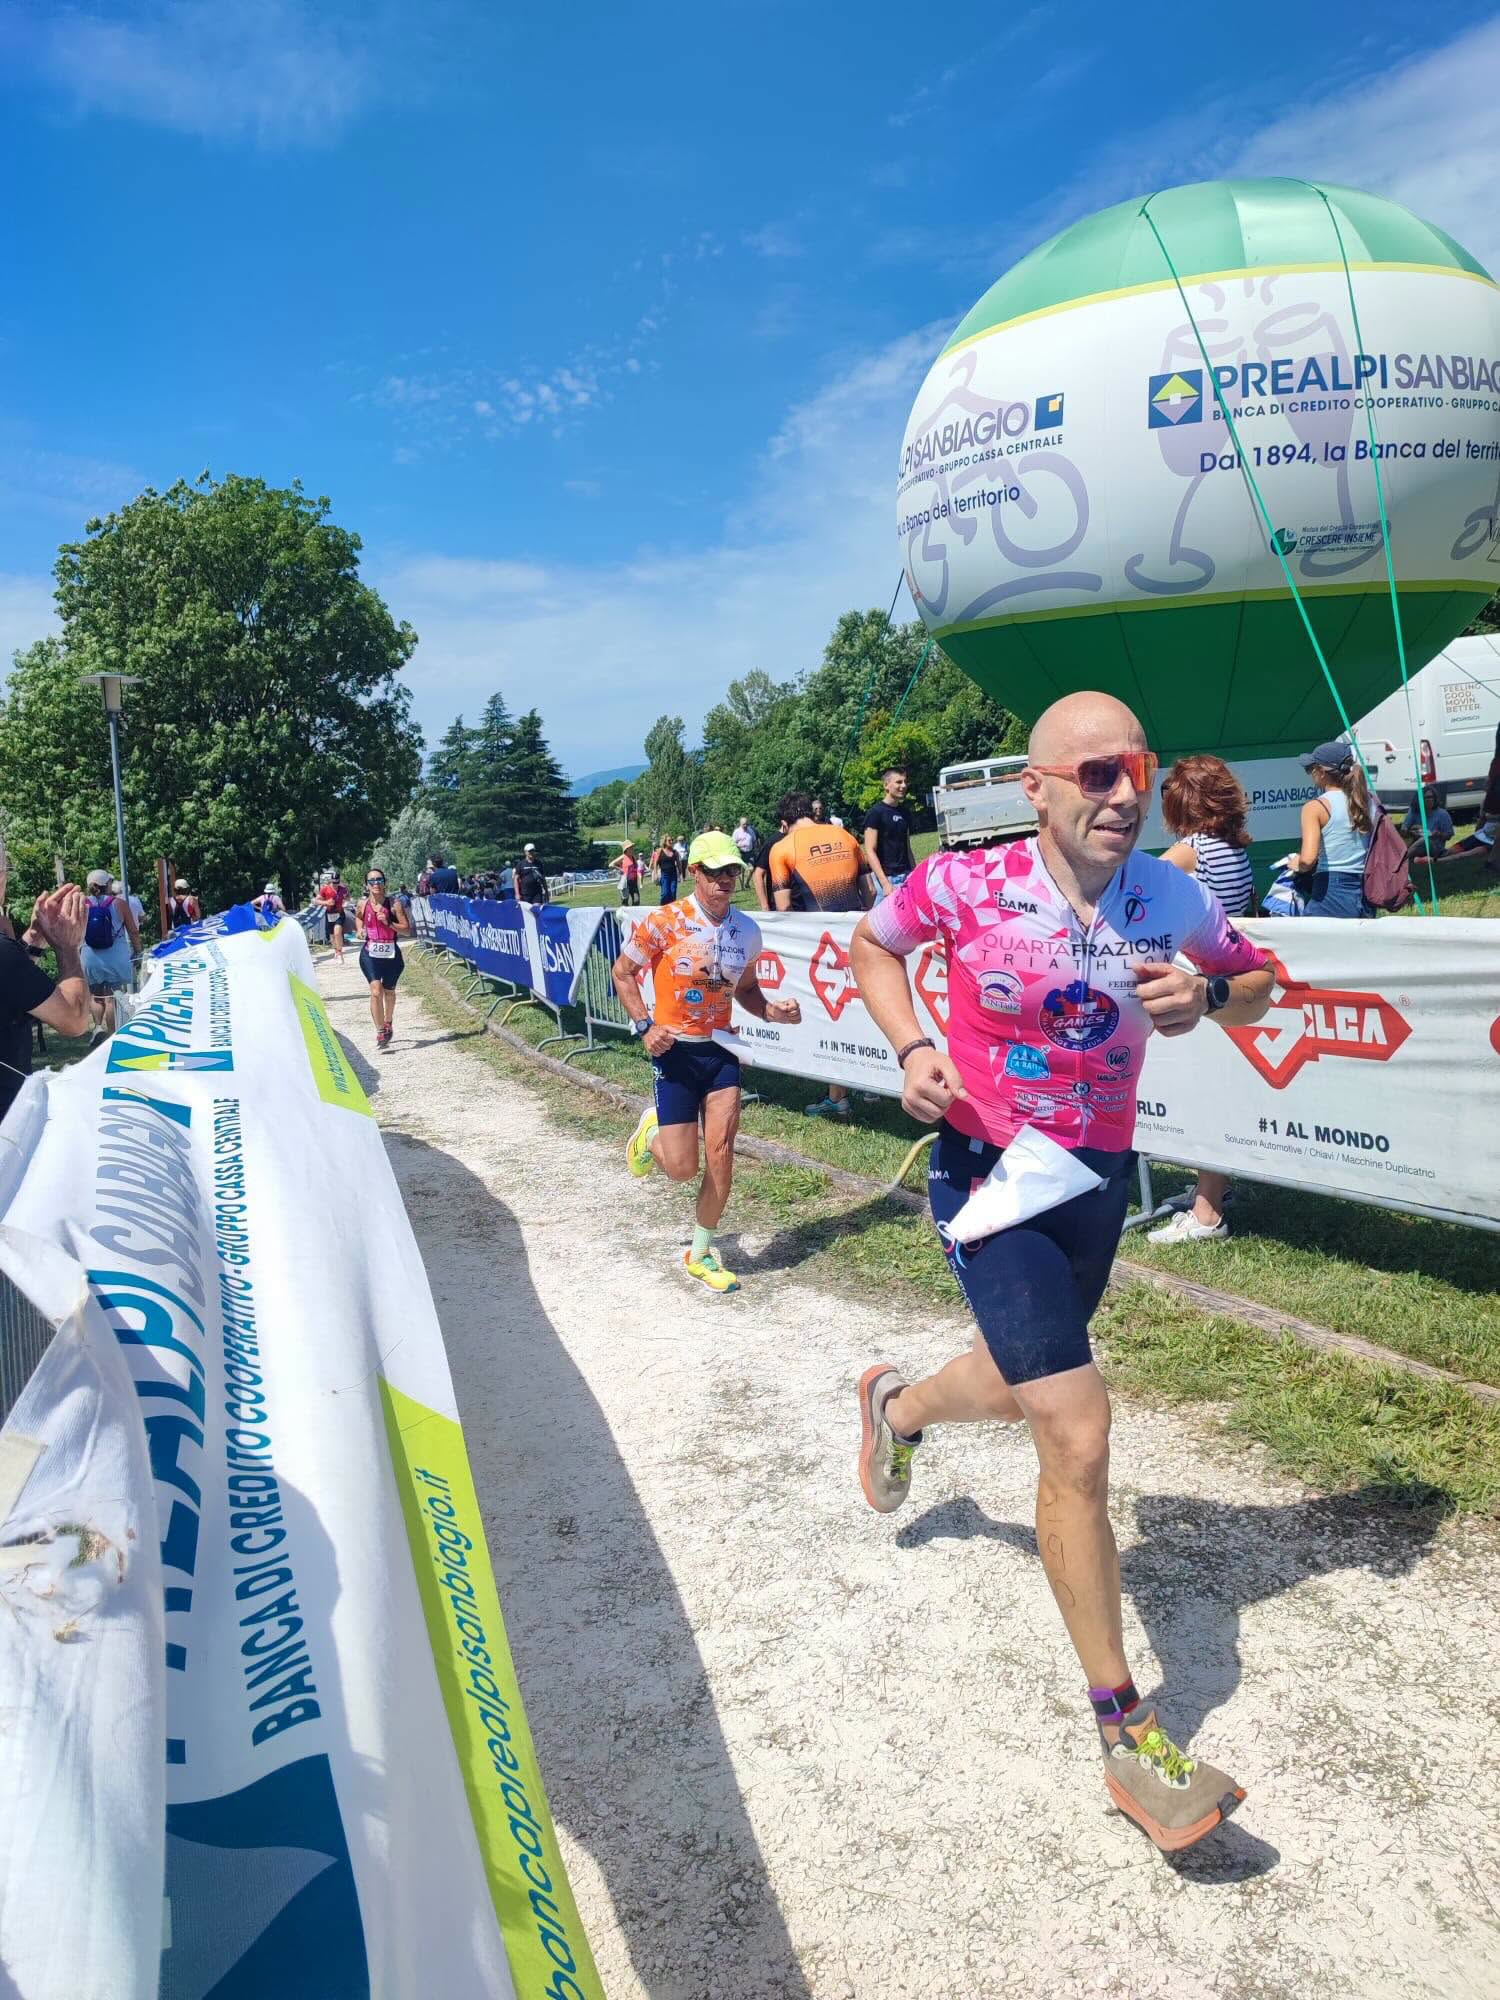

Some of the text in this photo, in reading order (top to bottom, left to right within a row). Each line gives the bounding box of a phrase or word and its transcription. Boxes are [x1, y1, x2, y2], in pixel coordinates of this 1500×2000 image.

[1213, 354, 1388, 402] PREALPI
[1270, 402, 1284, 415] DI
[1288, 399, 1350, 413] CREDITO
[1354, 396, 1443, 409] COOPERATIVO
[1451, 398, 1490, 411] GRUPPO
[913, 402, 1029, 469] SANBIAGIO
[939, 456, 970, 475] GRUPPO
[972, 447, 1003, 464] CASSA
[1006, 434, 1064, 455] CENTRALE
[1200, 449, 1242, 473] Dal
[1252, 442, 1317, 467] 1894,
[1324, 441, 1346, 462] la
[1354, 439, 1426, 460] Banca
[1432, 438, 1460, 459] del
[932, 498, 951, 520] del
[954, 485, 1020, 514] territorio
[1300, 532, 1377, 546] CRESCERE INSIEME
[998, 897, 1038, 914] DAMA
[372, 944, 391, 953] 282
[757, 959, 777, 981] LCA
[210, 992, 231, 1017] CREDITO
[210, 1025, 233, 1048] BANCA
[746, 1027, 754, 1037] AL
[755, 1029, 780, 1041] MONDO
[819, 1039, 888, 1060] #1 IN THE WORLD
[213, 1098, 243, 1154] CENTRALE
[1136, 1101, 1167, 1118] RLD
[1152, 1122, 1185, 1135] Machines
[1258, 1117, 1390, 1153] #1 AL MONDO
[1224, 1134, 1258, 1148] Soluzioni
[1259, 1139, 1303, 1155] Automotive
[1309, 1147, 1335, 1161] Chiavi
[1341, 1154, 1383, 1169] Macchine
[1385, 1161, 1436, 1179] Duplicatrici
[213, 1153, 247, 1201] CASSA
[215, 1203, 250, 1266] GRUPPO
[218, 1273, 269, 1424] COOPERATIVO
[225, 1428, 287, 1555] CREDITO
[233, 1553, 294, 1601] DI
[240, 1588, 322, 1747] BANCA
